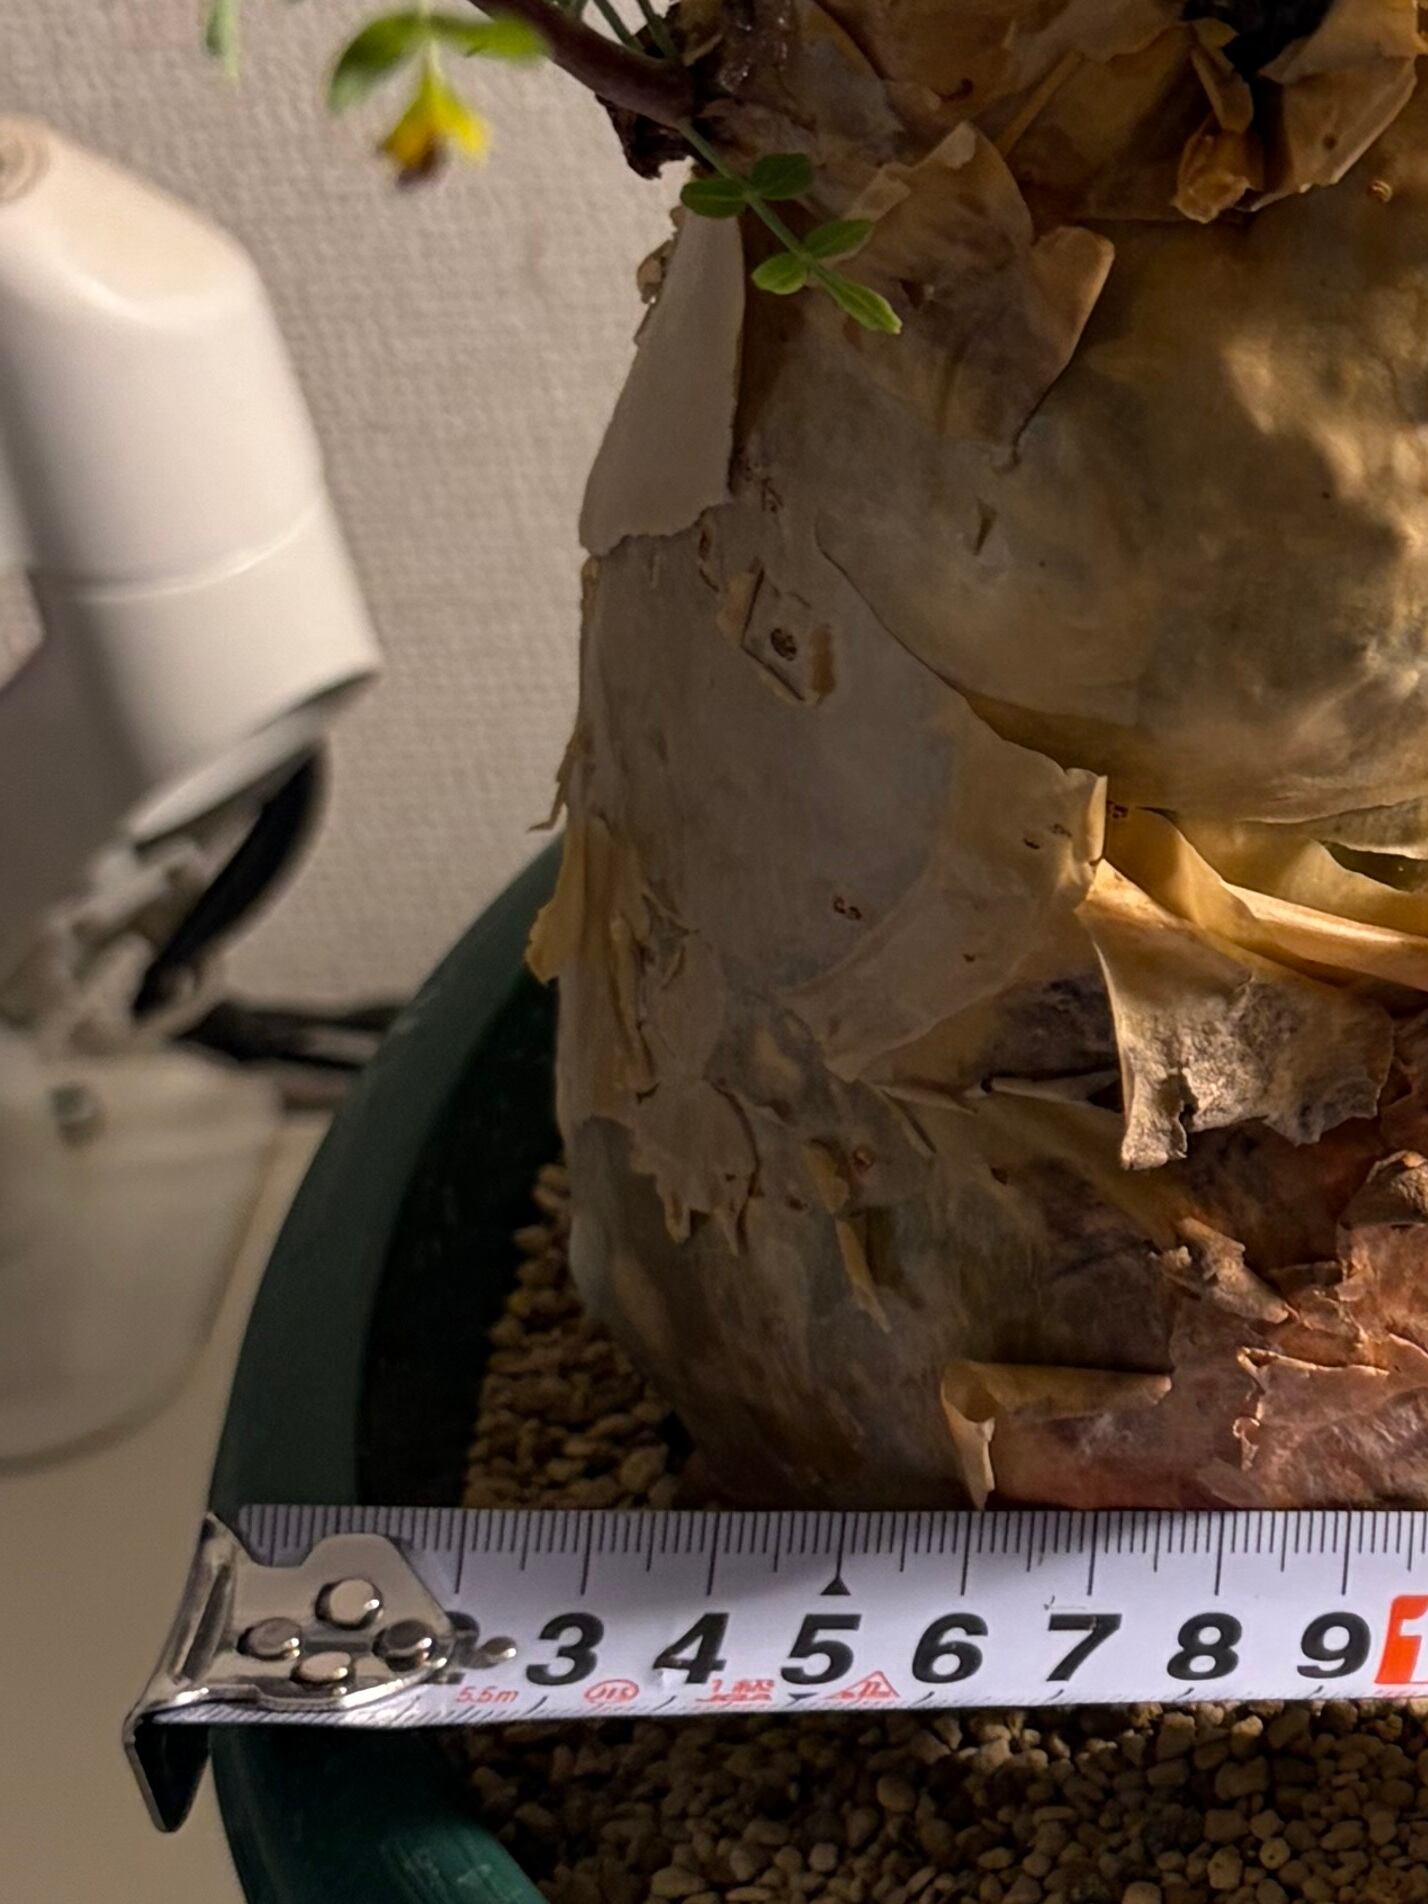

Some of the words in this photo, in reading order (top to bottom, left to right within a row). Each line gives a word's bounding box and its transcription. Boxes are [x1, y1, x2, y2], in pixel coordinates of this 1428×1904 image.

[524, 1611, 605, 1687] 3
[650, 1612, 730, 1686] 4
[779, 1613, 862, 1686] 5
[911, 1612, 989, 1685] 6
[1045, 1613, 1123, 1683] 7
[1166, 1611, 1243, 1682] 8
[1296, 1611, 1372, 1680] 9
